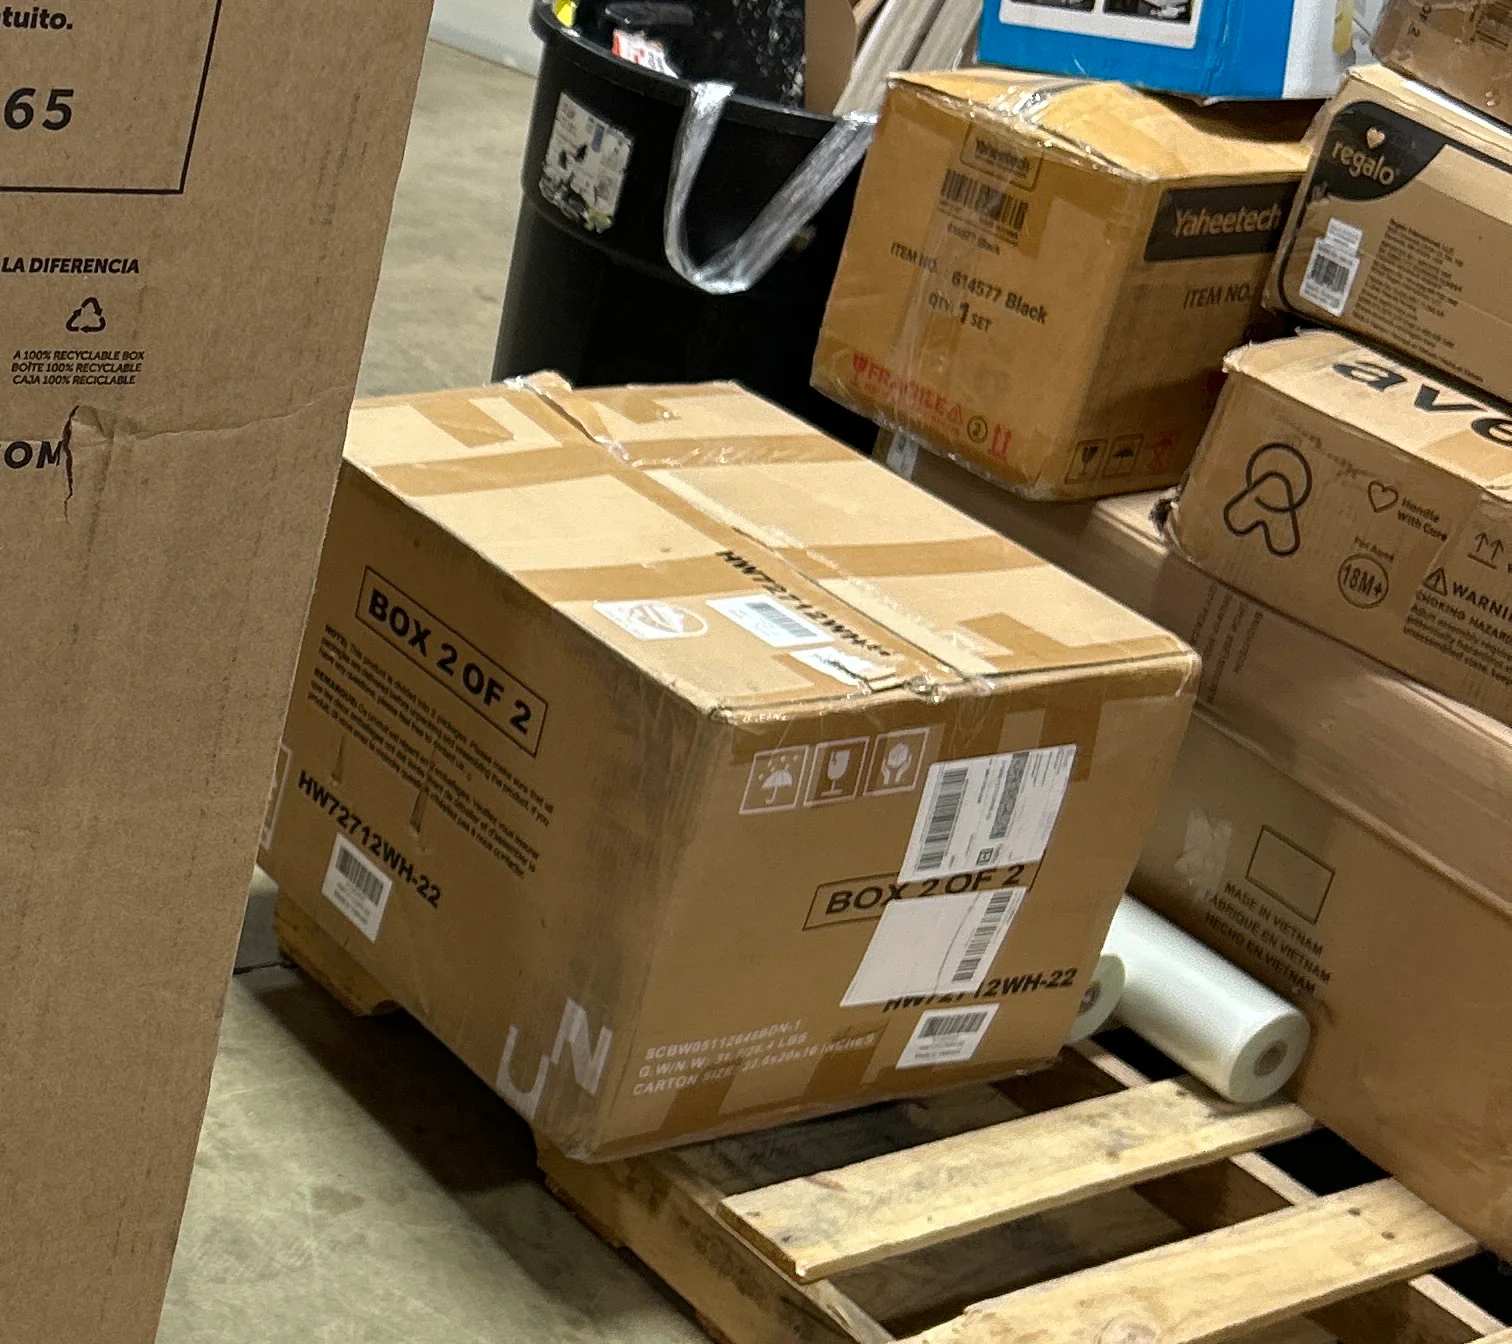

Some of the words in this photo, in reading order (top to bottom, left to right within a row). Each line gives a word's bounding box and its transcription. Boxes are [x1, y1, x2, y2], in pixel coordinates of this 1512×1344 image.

[1332, 141, 1395, 186] regalo
[1173, 203, 1282, 238] Yaheetech
[1, 256, 24, 272] LA
[28, 257, 139, 273] DIFERENCIA
[1005, 292, 1048, 324] Black
[12, 350, 20, 359] A
[1342, 563, 1382, 597] 18M+
[368, 587, 431, 658] BOX
[438, 642, 459, 677] 2
[462, 662, 505, 708] OF
[510, 700, 532, 735] 2
[297, 769, 441, 909] HW72712WH-22
[826, 883, 902, 915] BOX
[945, 872, 993, 895] OF
[1003, 864, 1025, 886] 2
